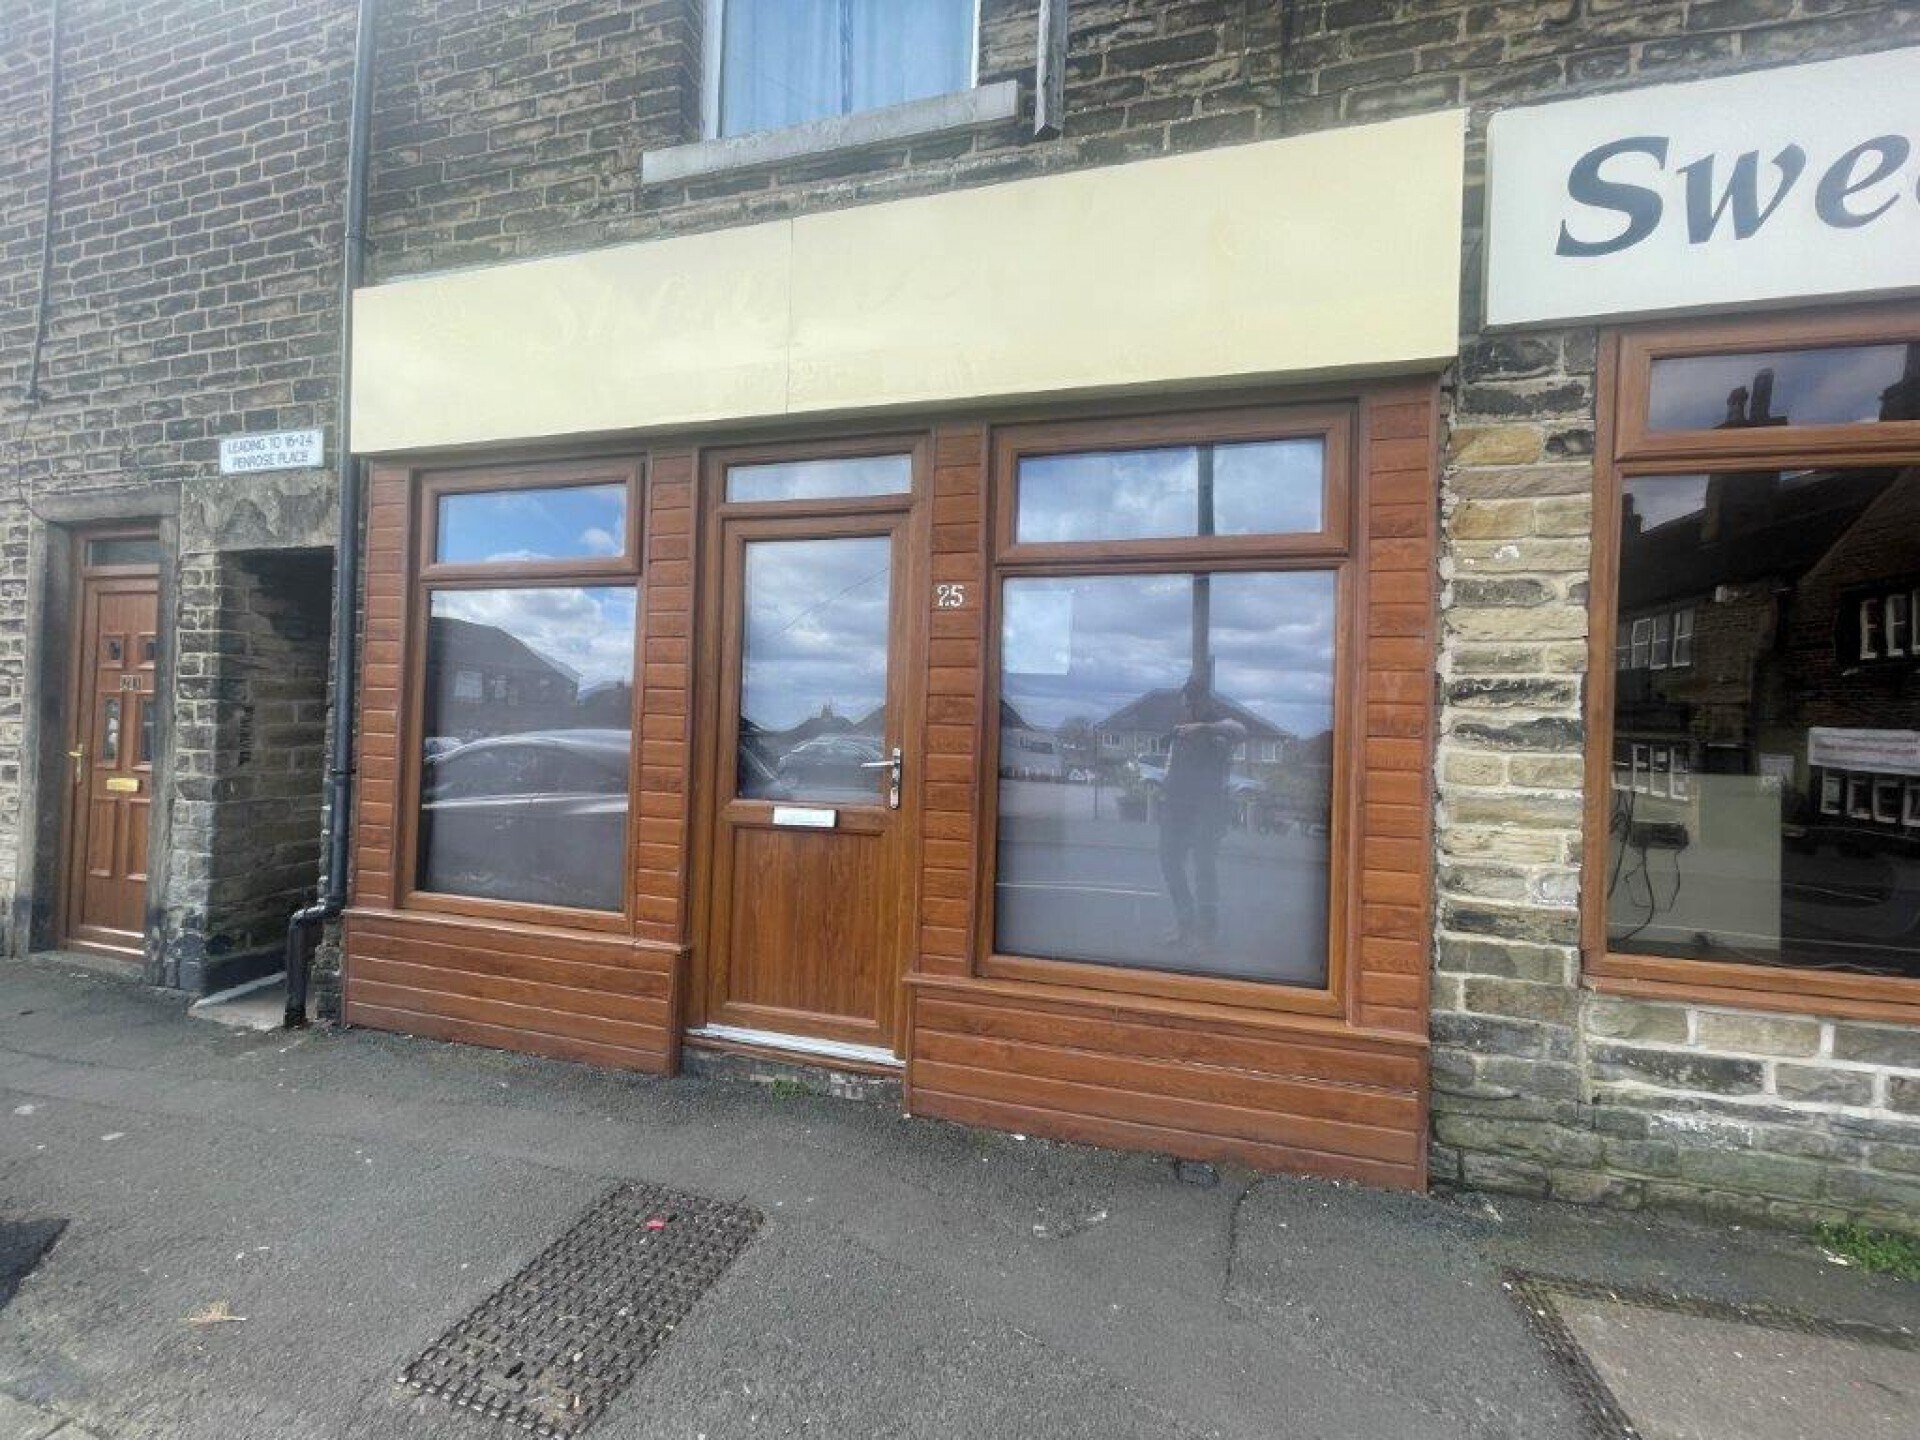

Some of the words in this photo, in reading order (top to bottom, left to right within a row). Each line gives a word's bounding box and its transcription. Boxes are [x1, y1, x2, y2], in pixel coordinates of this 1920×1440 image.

[1556, 135, 1920, 258] Swe
[228, 438, 265, 454] LEADING
[270, 436, 281, 449] TO
[278, 449, 309, 464] PLACE
[937, 584, 964, 607] 25
